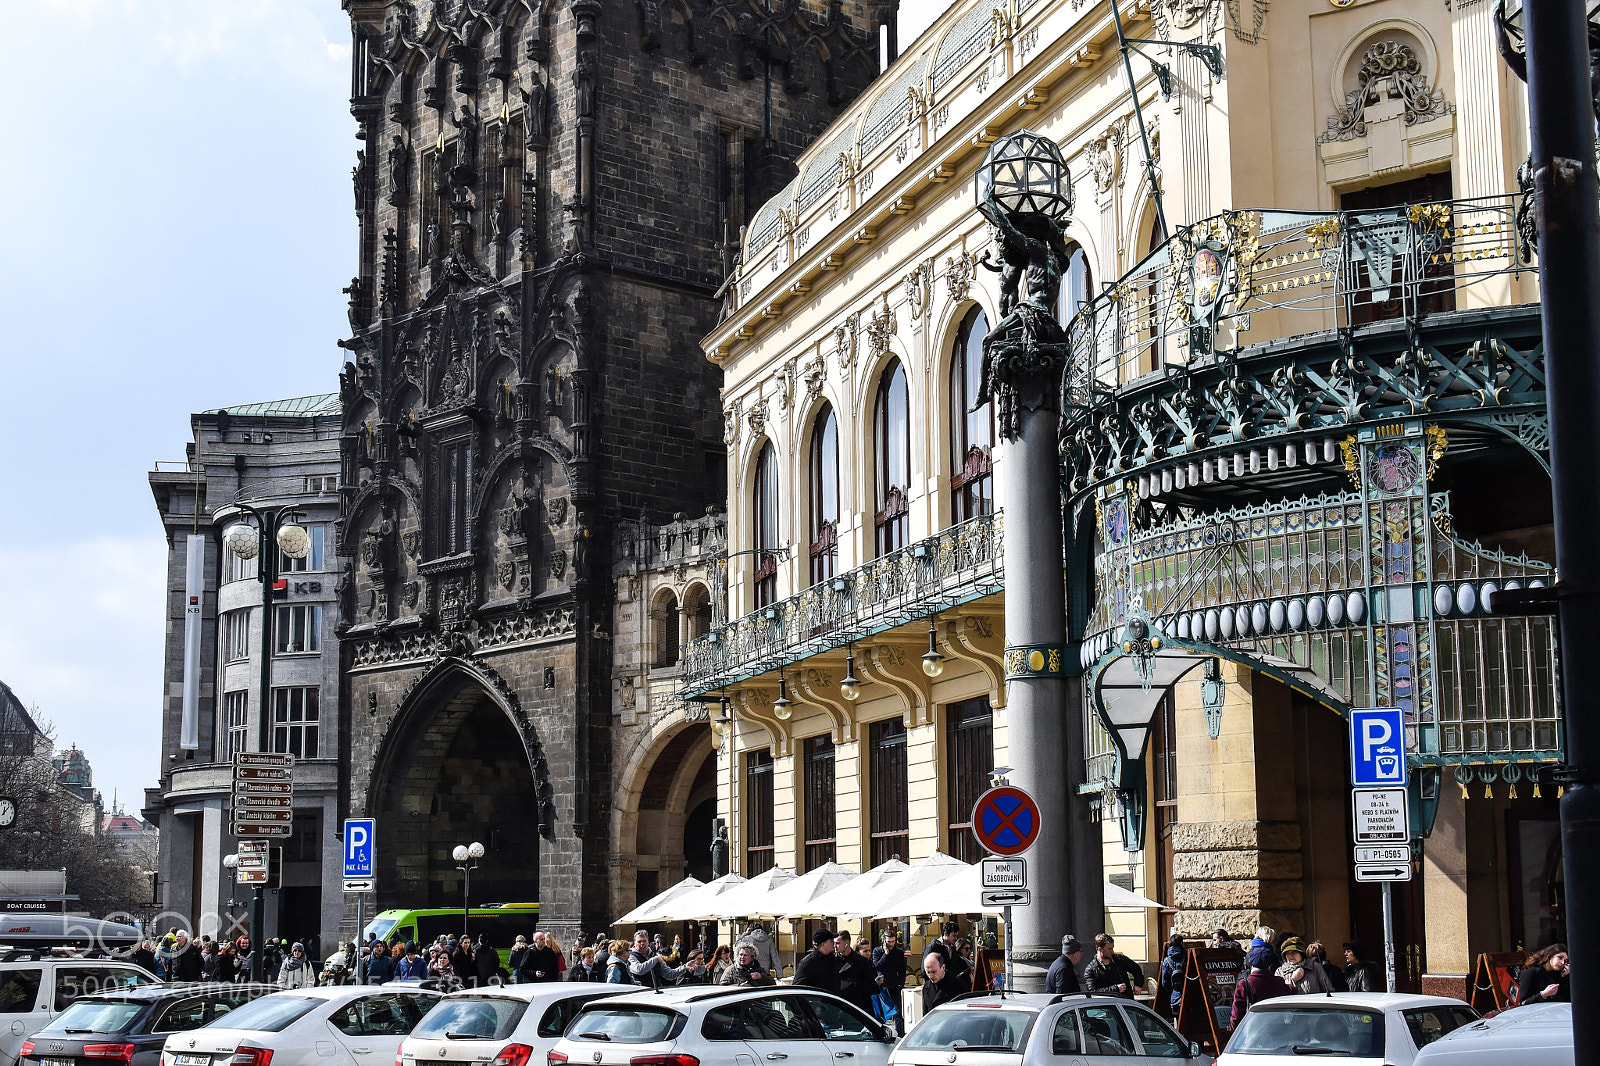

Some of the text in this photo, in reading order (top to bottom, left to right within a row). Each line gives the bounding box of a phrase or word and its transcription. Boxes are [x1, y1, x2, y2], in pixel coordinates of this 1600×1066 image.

[294, 581, 322, 594] KB
[1362, 718, 1392, 762] P
[349, 826, 368, 860] P
[1373, 850, 1402, 859] P1-0505
[995, 864, 1011, 873] MIMO
